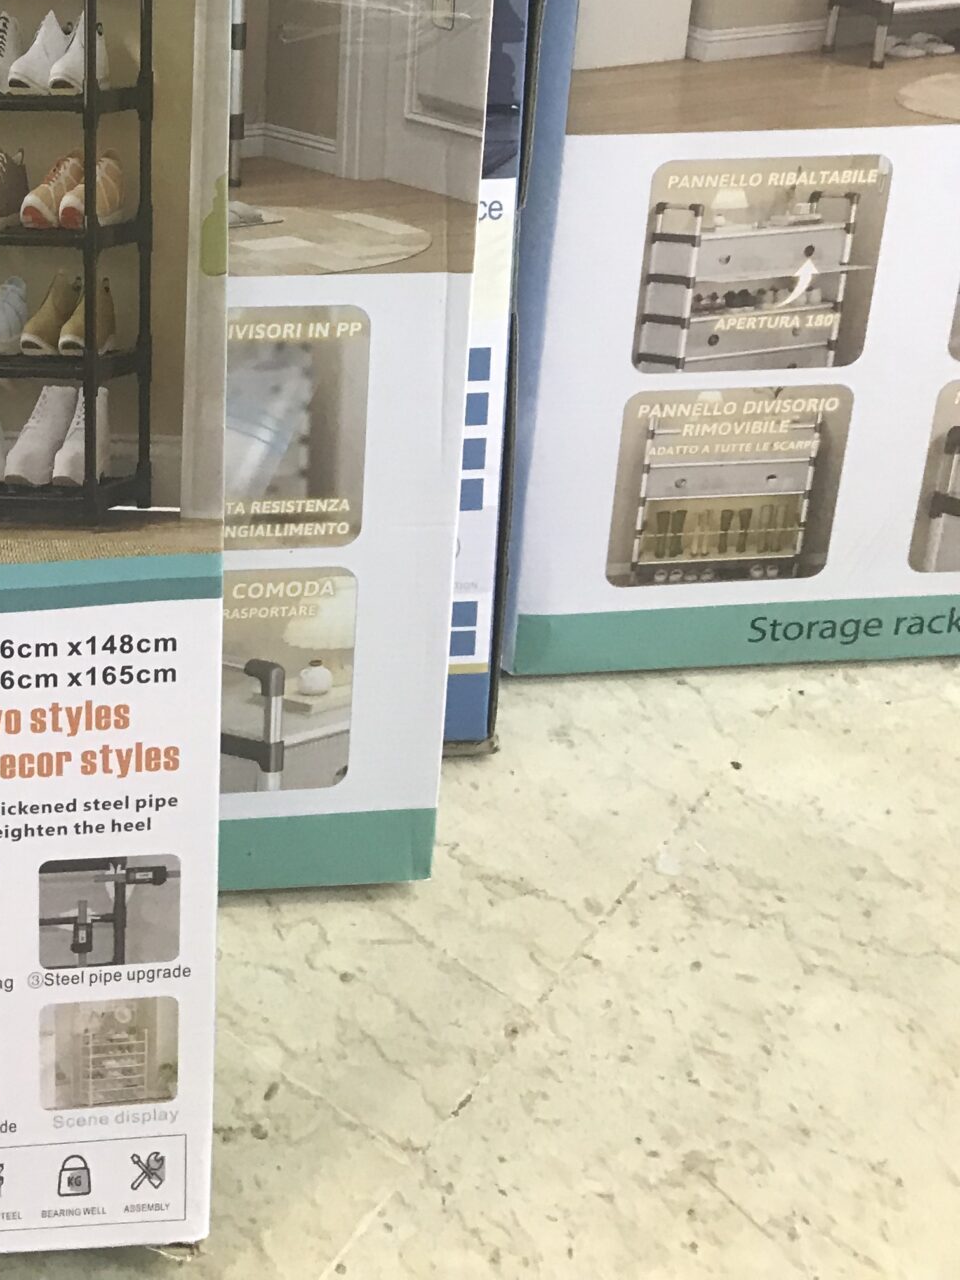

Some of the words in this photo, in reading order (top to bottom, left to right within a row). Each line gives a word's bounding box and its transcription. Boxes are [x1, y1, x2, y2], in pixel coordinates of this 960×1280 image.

[667, 172, 763, 190] PANNELLO
[767, 168, 879, 187] RIBALTABILE
[228, 322, 302, 339] IVISORI
[308, 322, 330, 338] IN
[336, 321, 362, 338] PP
[714, 315, 800, 331] APERTURA
[637, 401, 737, 418] PANNELLO
[743, 397, 839, 415] DIVISORIO
[681, 419, 790, 437] RIMOVIBILE
[648, 444, 699, 456] ADATTO
[701, 444, 710, 454] A
[714, 441, 752, 453] TUTTE
[755, 441, 770, 453] LE
[773, 439, 820, 452] SCARPE
[250, 498, 350, 514] RESISTENZA
[232, 580, 335, 599] COMODA
[747, 614, 882, 646] Storage
[67, 633, 178, 658] x148cm
[67, 664, 178, 688] x165cm
[30, 700, 131, 737] styles
[80, 742, 180, 778] styles
[83, 796, 130, 812] steel
[135, 794, 178, 814] pipe
[74, 820, 104, 836] the
[110, 818, 151, 833] heel
[88, 969, 122, 988] pipe
[127, 965, 192, 984] upgrade
[53, 1113, 109, 1130] Scene
[115, 1106, 180, 1125] display
[67, 1176, 82, 1187] KG
[41, 1208, 82, 1219] BEARING
[83, 1206, 107, 1216] WELL
[123, 1202, 171, 1214] ASSEMBLY
